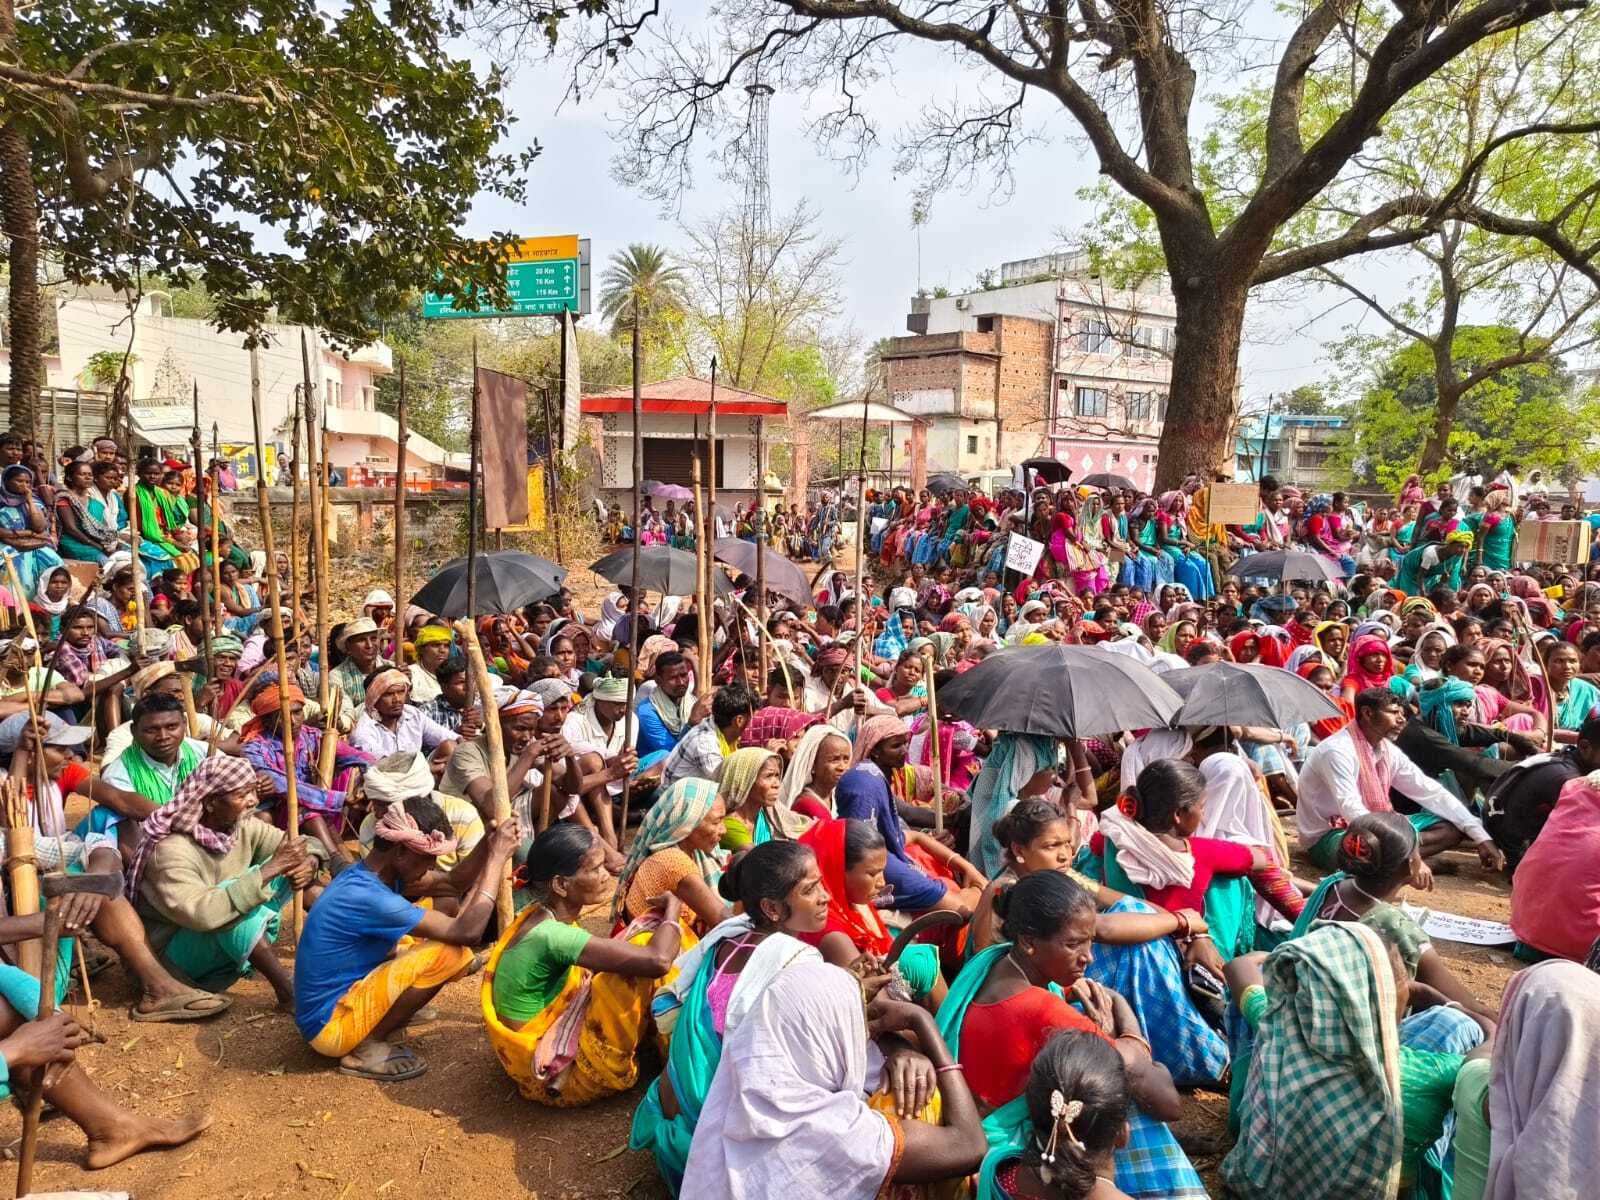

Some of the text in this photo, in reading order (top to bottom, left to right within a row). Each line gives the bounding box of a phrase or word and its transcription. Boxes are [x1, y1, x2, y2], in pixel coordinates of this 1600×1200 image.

[544, 267, 555, 275] Km
[544, 278, 555, 286] Km
[548, 288, 559, 297] Km
